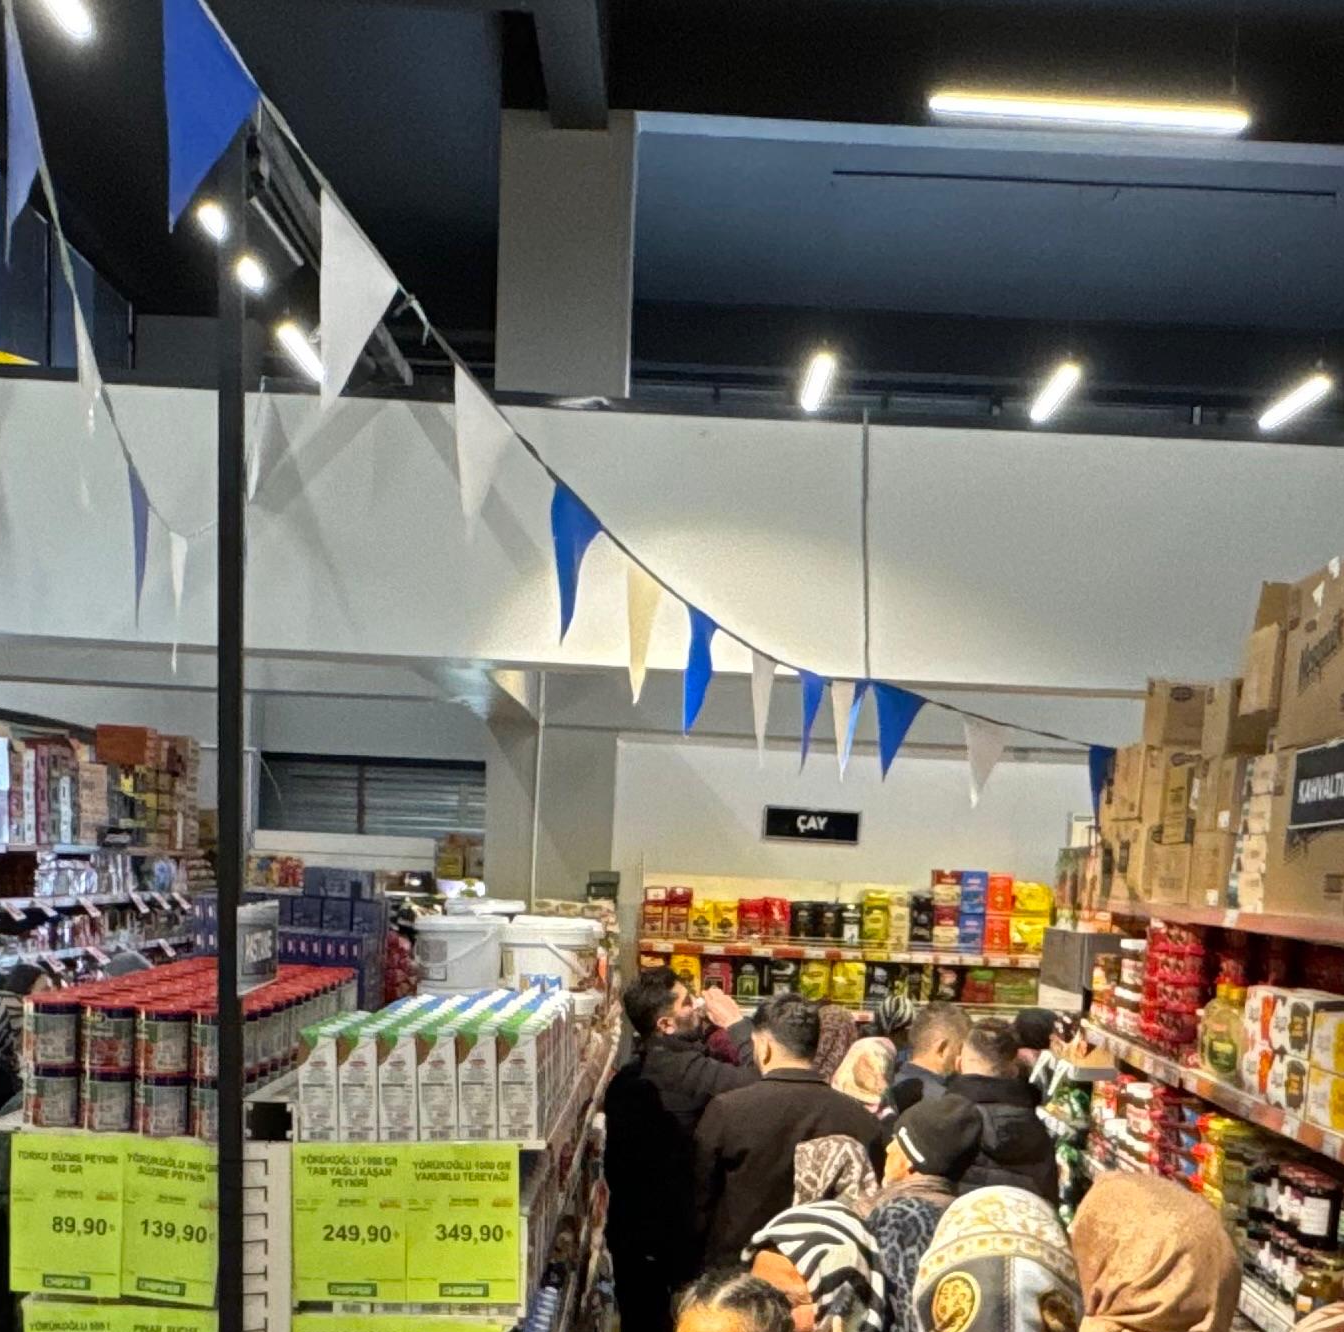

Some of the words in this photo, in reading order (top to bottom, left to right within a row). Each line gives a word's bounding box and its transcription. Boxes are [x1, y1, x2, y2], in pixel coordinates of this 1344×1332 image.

[797, 814, 828, 833] ÇAY
[52, 1215, 107, 1237] 89,90
[140, 1218, 207, 1244] 139,90
[322, 1224, 392, 1246] 249,90
[435, 1223, 505, 1246] 349,90
